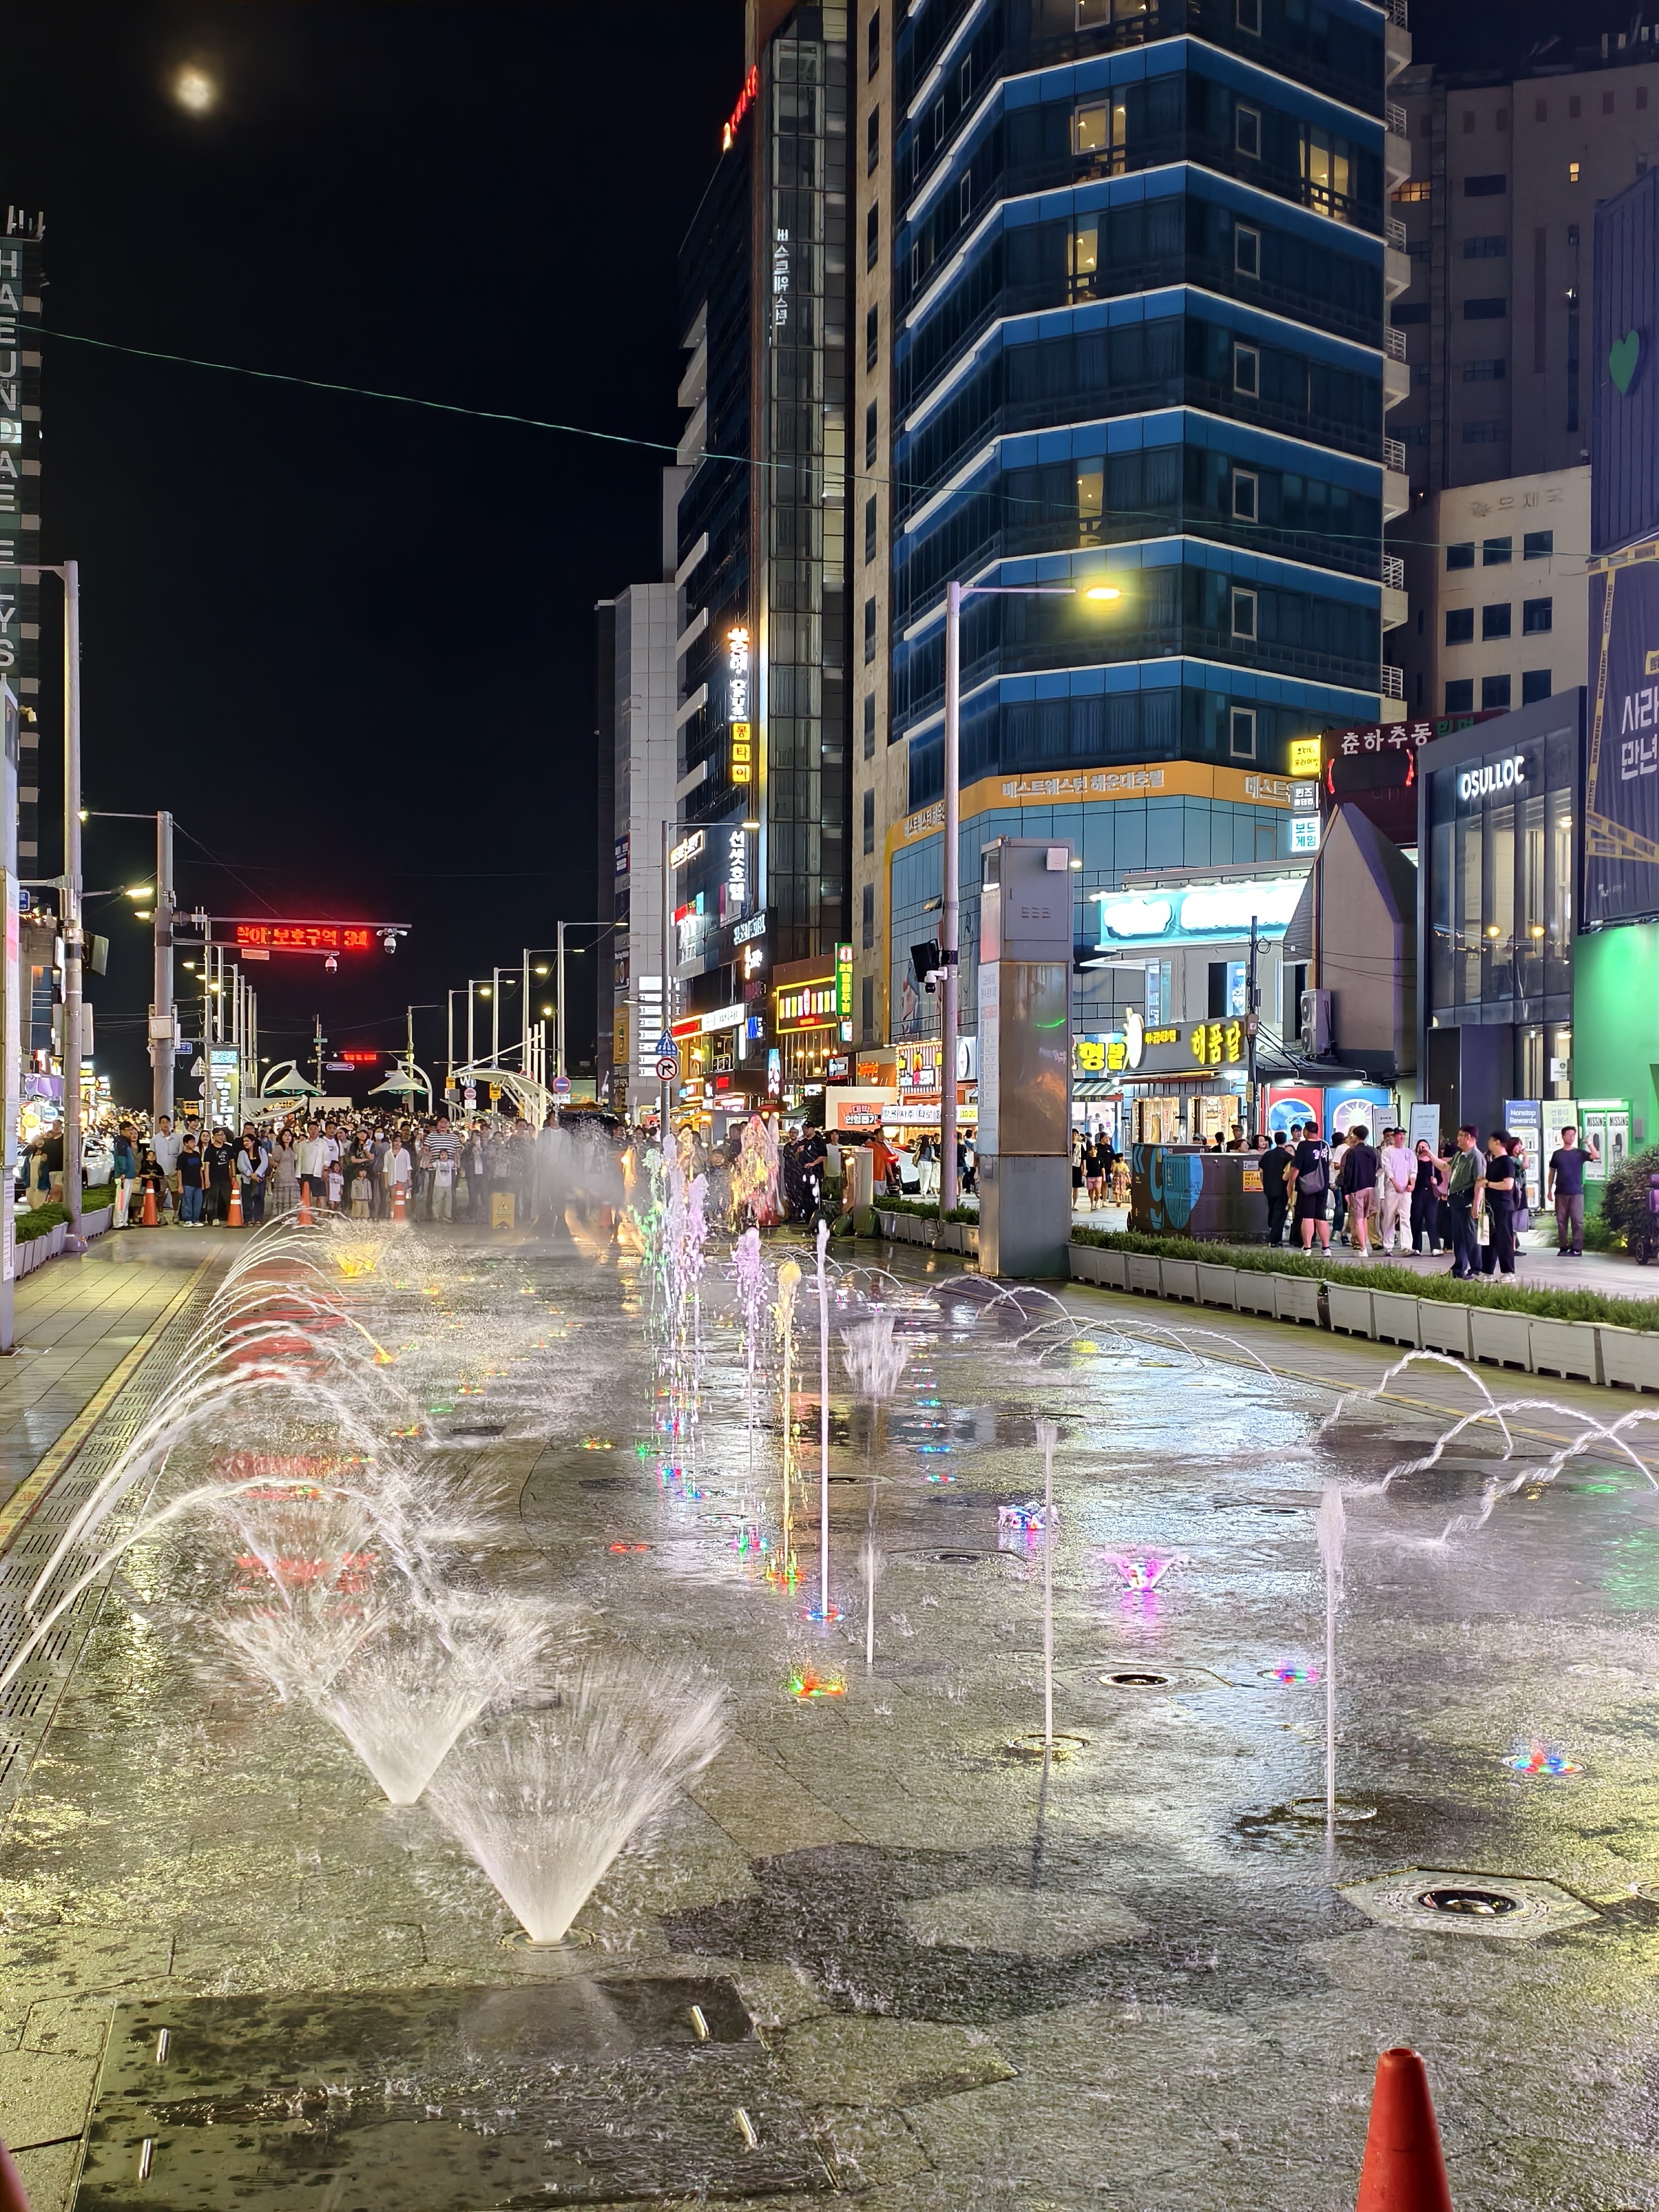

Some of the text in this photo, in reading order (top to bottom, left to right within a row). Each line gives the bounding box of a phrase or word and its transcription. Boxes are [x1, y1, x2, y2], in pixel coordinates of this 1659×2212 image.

[1598, 650, 1607, 699] WARNING
[1341, 723, 1432, 755] 춘하추동
[1593, 714, 1602, 764] WARNING
[1002, 770, 1164, 798] 베스트웨스턴 해운대호텔
[1459, 756, 1525, 801] OSULLOC
[1296, 822, 1316, 833] 보드
[1296, 835, 1316, 847] 게임
[1587, 1116, 1606, 1127] MISSING
[1609, 1116, 1629, 1127] MISSING
